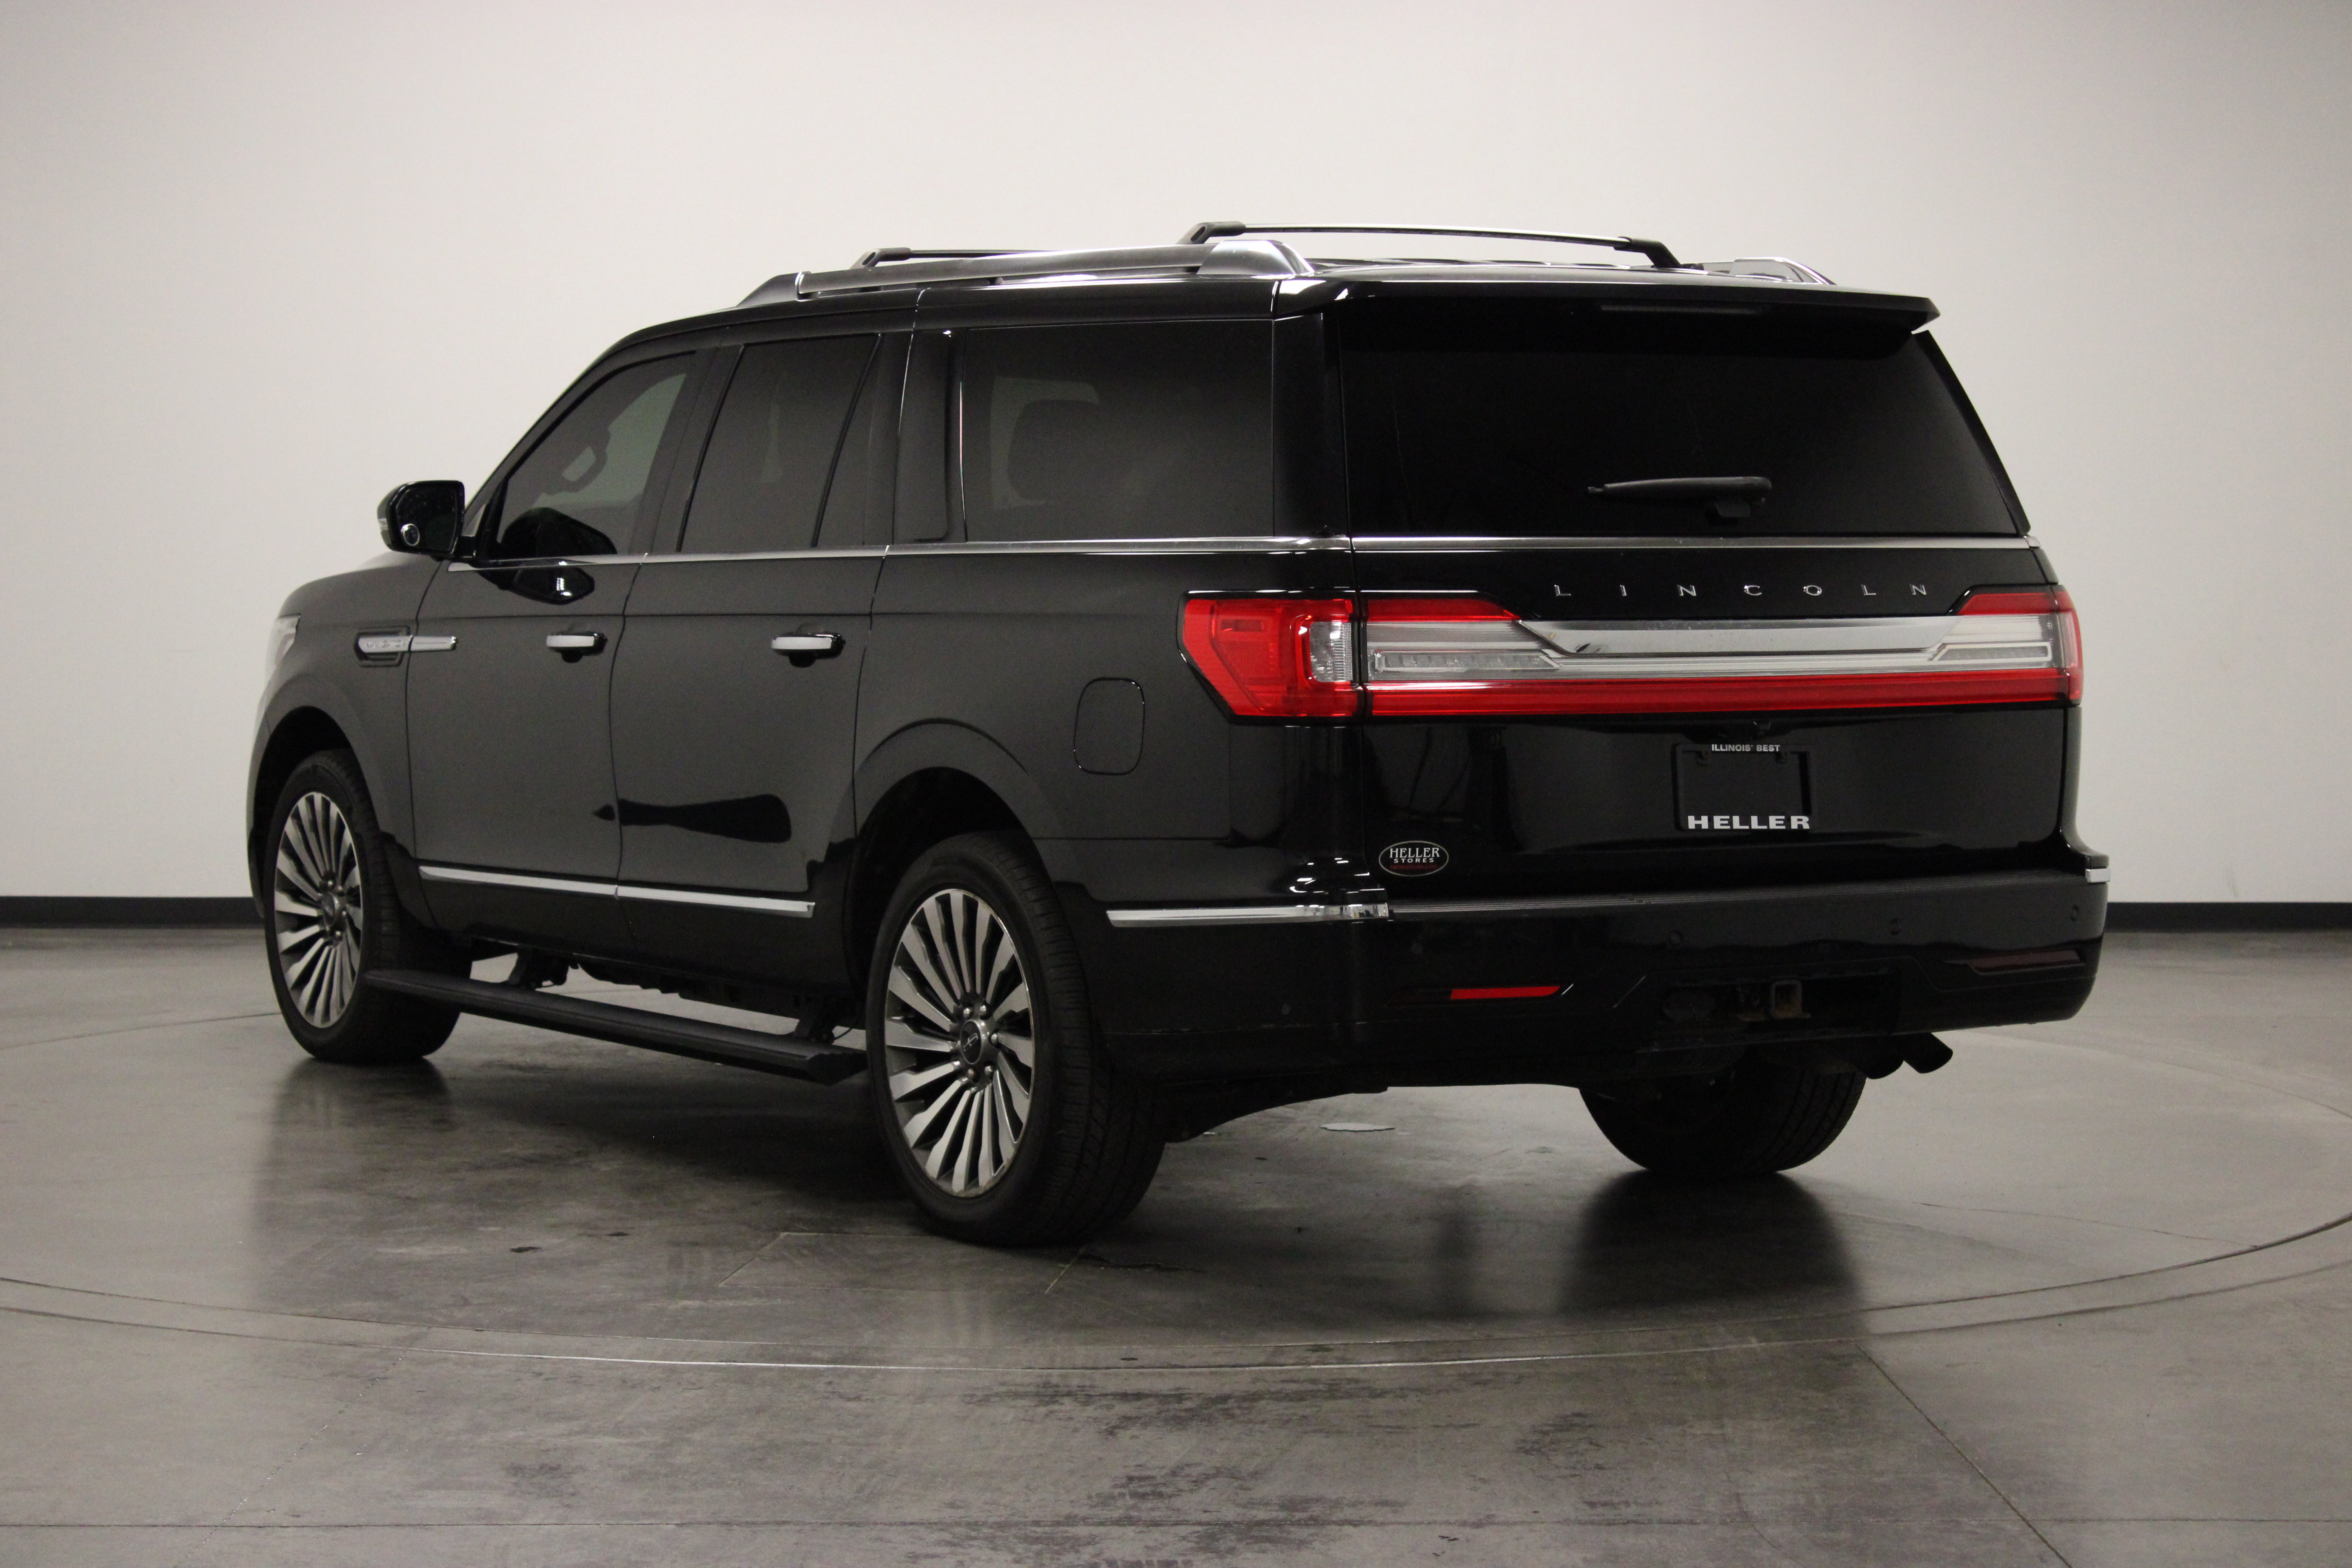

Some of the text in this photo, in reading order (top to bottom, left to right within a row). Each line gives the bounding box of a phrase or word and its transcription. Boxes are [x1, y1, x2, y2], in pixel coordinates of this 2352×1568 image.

[1554, 584, 1927, 597] LINCOLN
[1688, 815, 1810, 829] HELLER
[1390, 847, 1440, 858] HELLER
